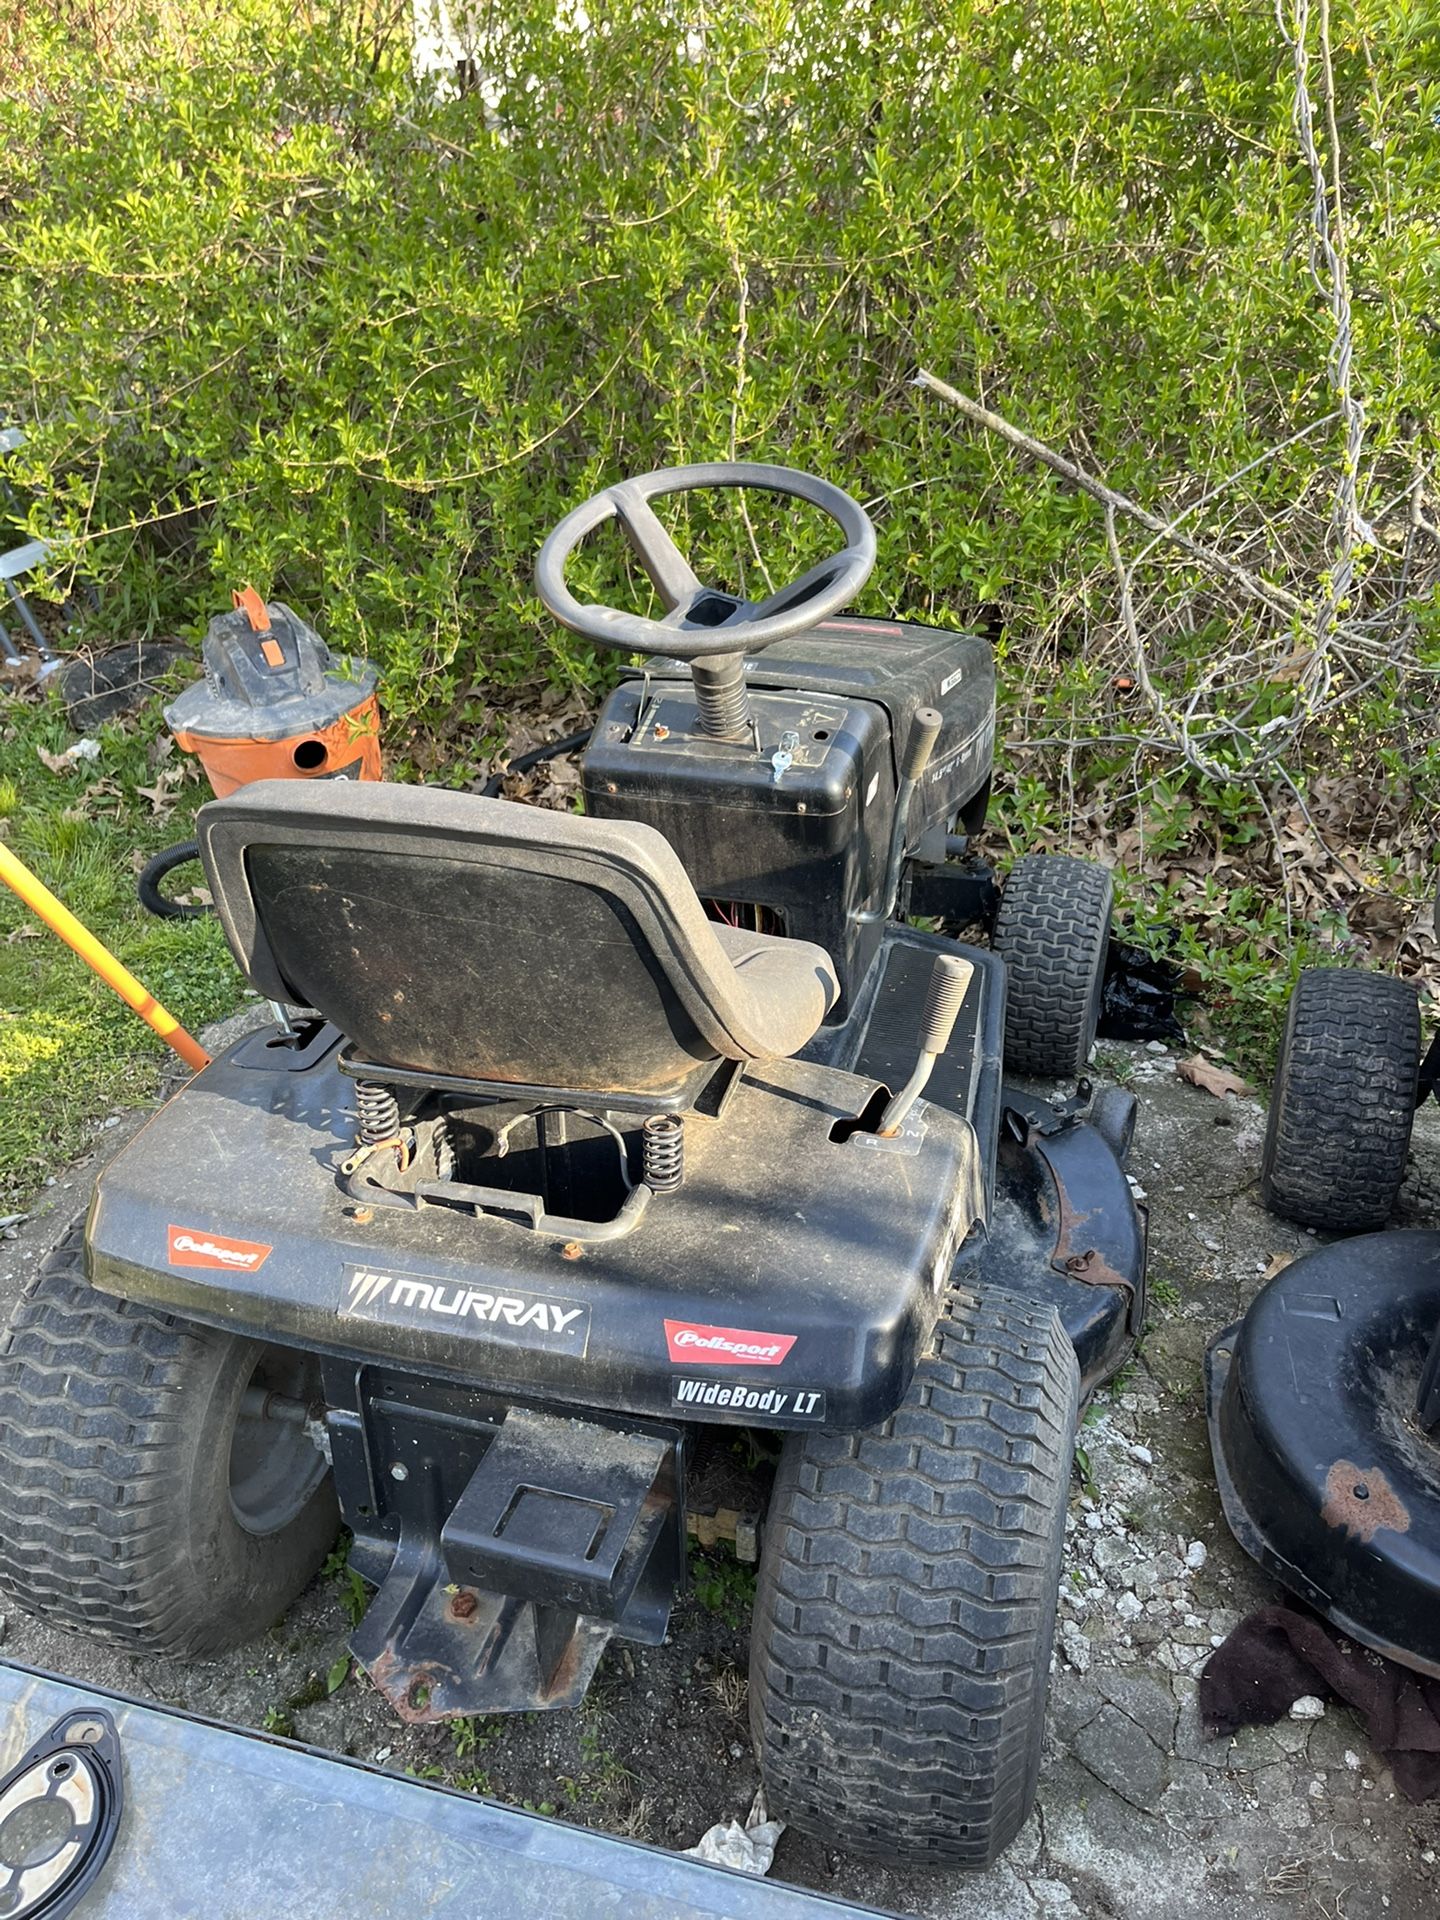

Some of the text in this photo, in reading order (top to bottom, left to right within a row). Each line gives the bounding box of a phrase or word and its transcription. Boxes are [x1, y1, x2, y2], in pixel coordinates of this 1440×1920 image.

[389, 1280, 584, 1334] MURRAY
[674, 1330, 782, 1358] Polisport
[676, 1379, 821, 1414] WideBody LT
